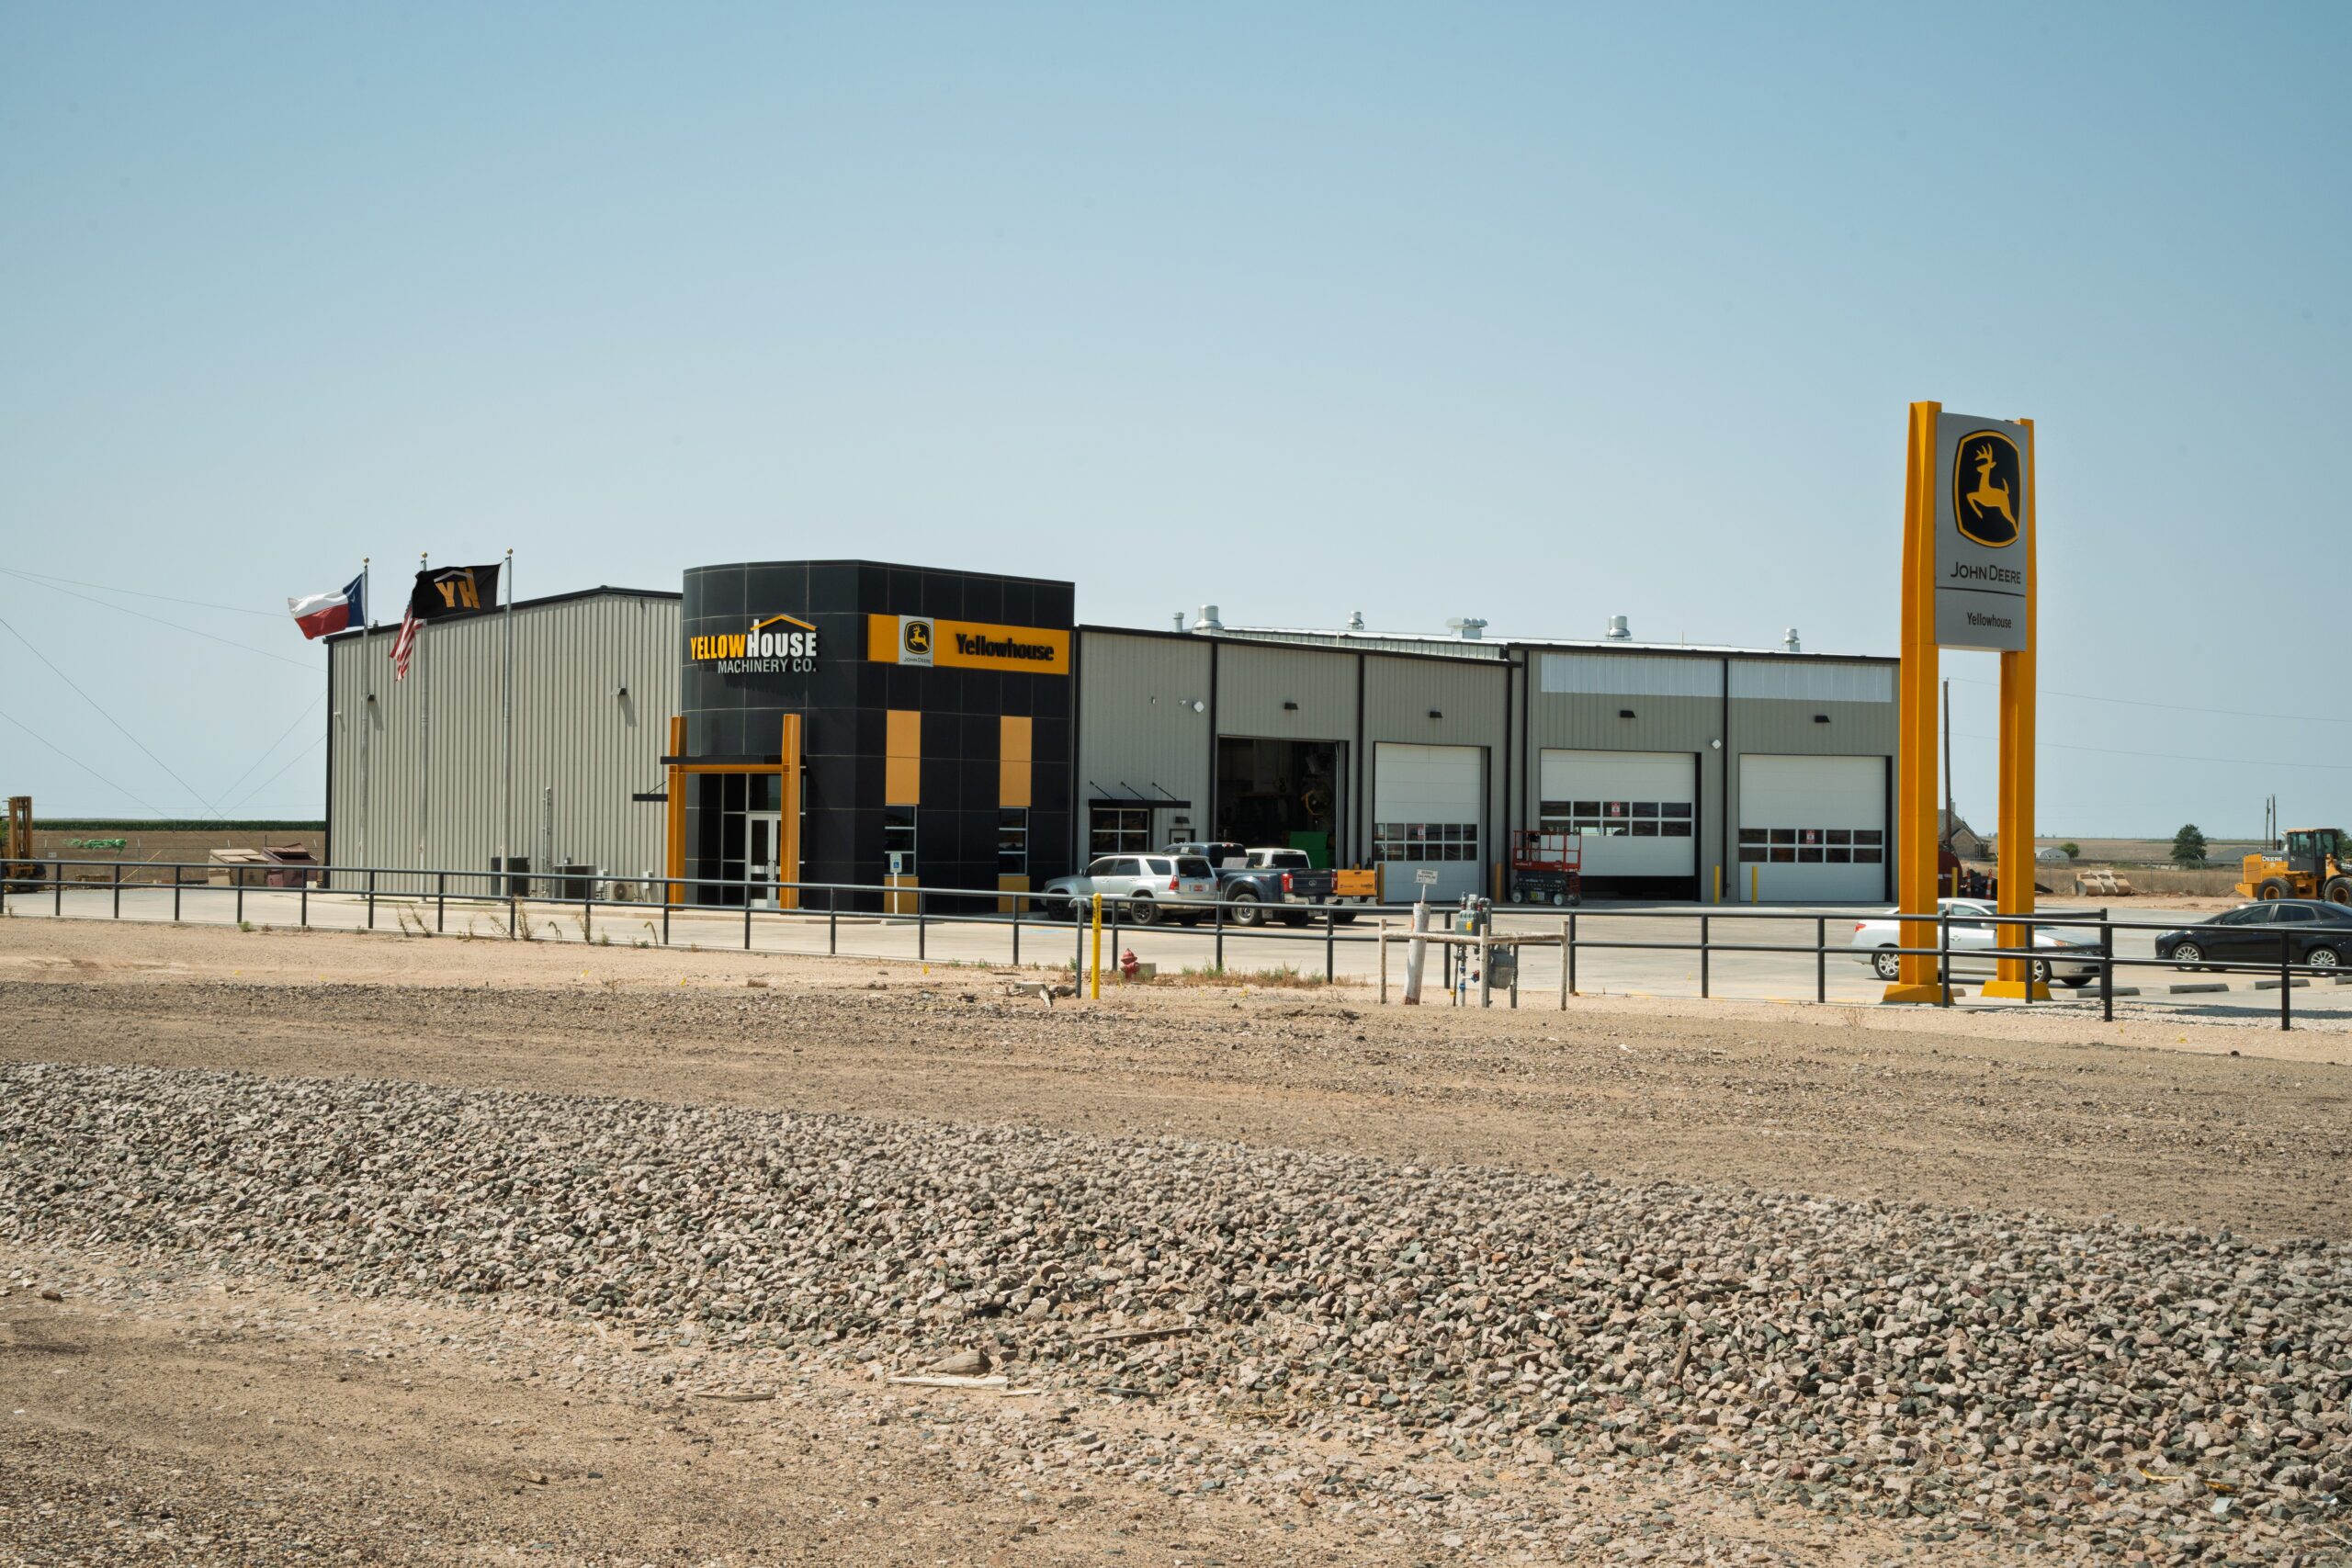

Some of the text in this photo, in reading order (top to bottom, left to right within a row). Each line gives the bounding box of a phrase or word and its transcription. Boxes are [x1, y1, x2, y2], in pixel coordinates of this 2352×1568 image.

[1950, 561, 2021, 584] JOHN DEERE
[1966, 612, 2012, 628] Yellowhouse
[955, 633, 1055, 660] Yellowhouse
[718, 659, 817, 673] MACHINERY CO.
